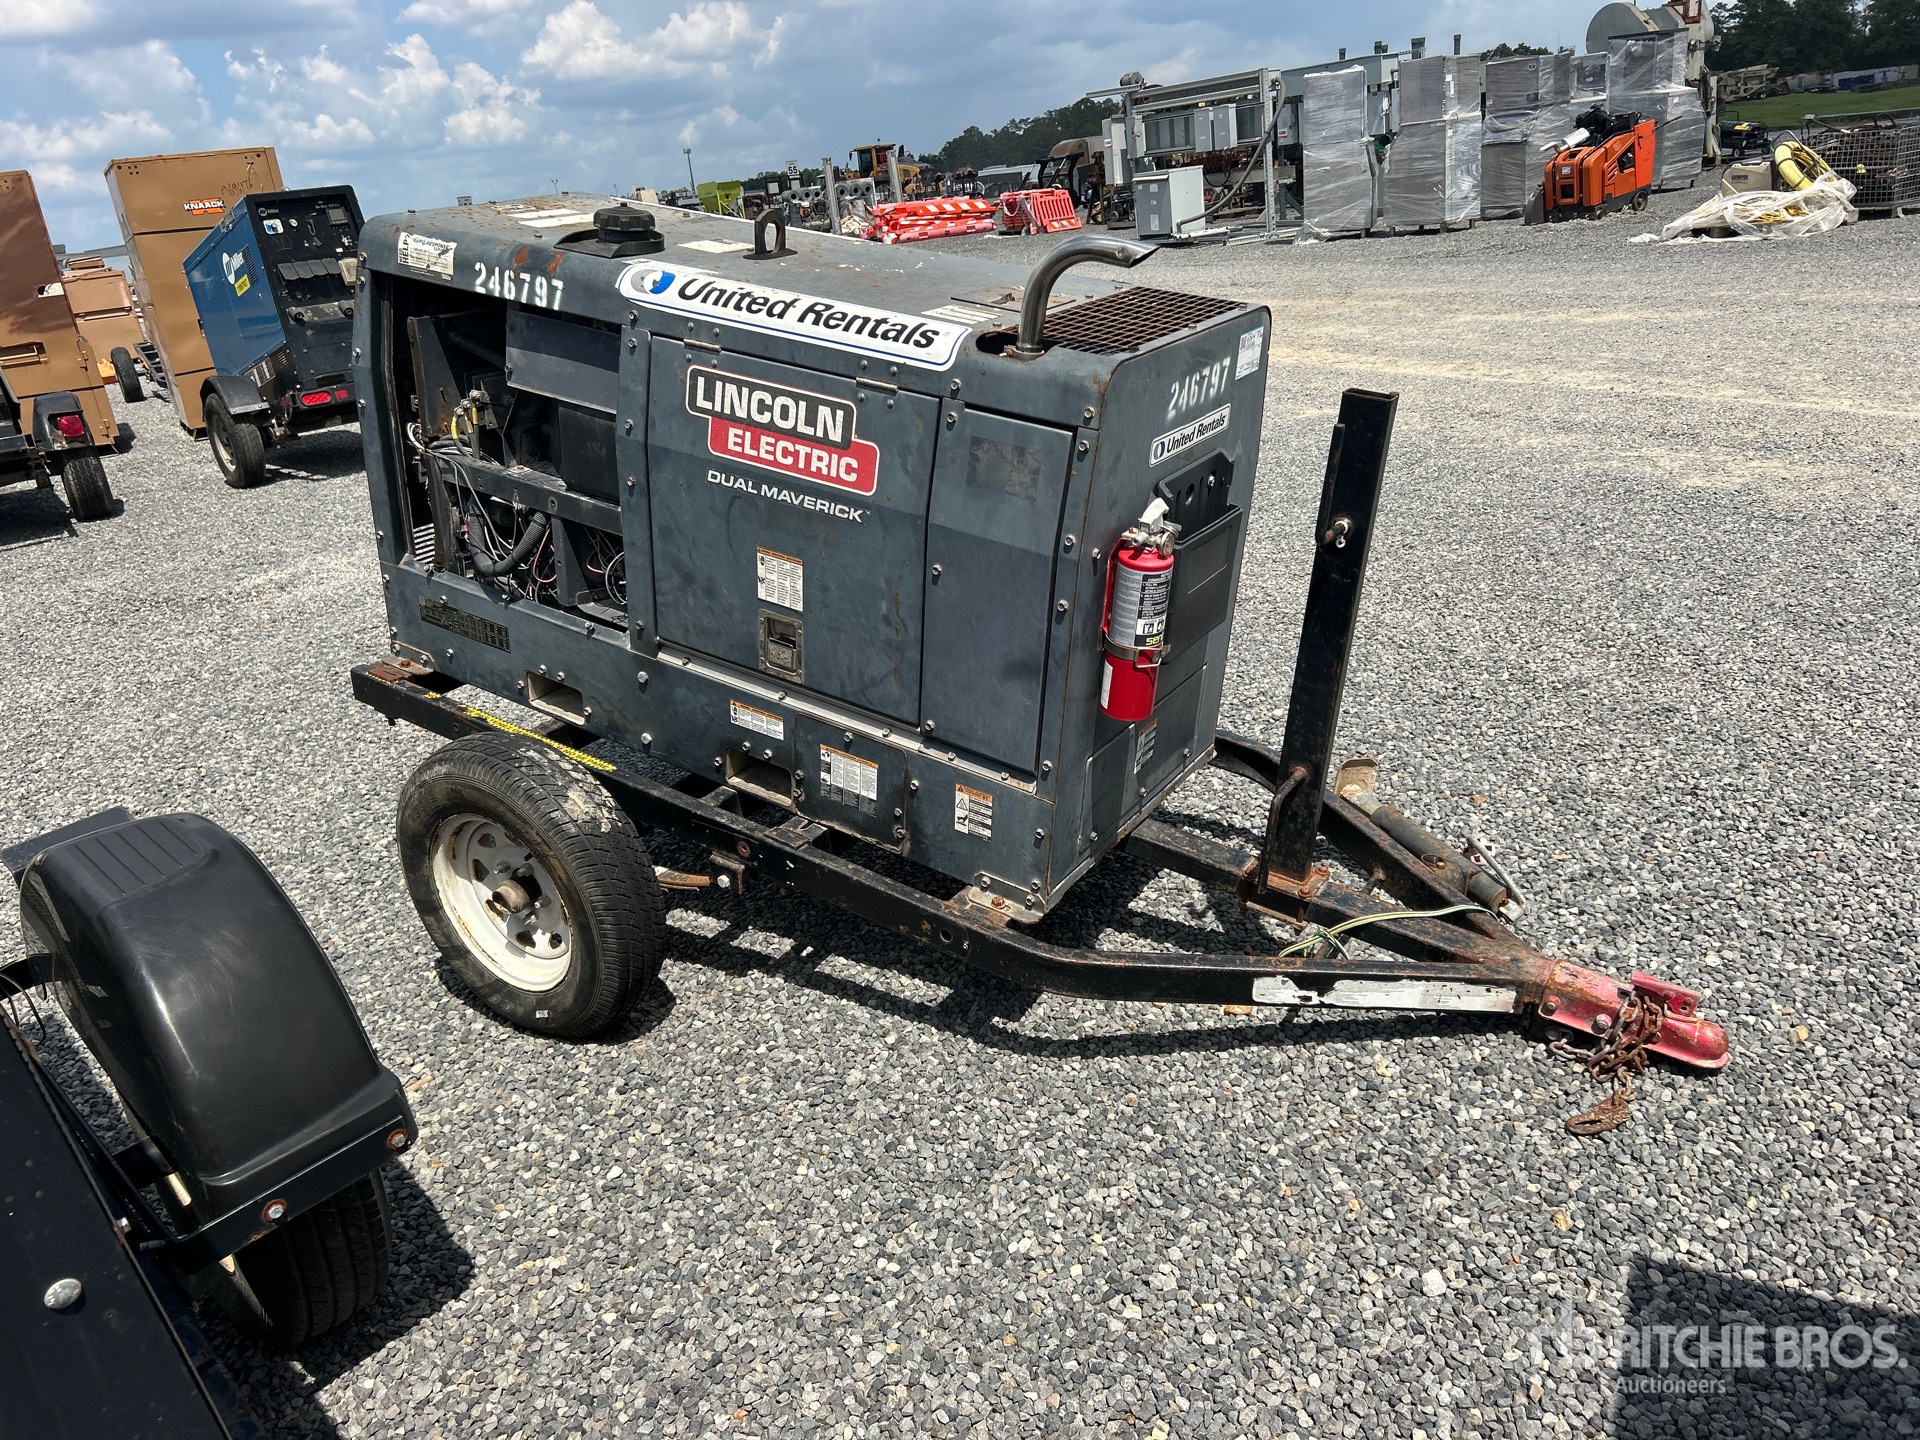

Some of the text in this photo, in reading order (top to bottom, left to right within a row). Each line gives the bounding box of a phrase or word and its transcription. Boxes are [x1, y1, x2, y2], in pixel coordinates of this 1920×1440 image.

[788, 166, 798, 174] 55
[184, 200, 225, 212] KNAACK
[231, 252, 245, 271] Miller
[403, 234, 411, 264] HELP?
[474, 261, 565, 311] 246797
[677, 278, 800, 320] United
[797, 301, 941, 349] Rentals
[695, 375, 844, 443] LINCOLN
[1166, 356, 1232, 420] 246797
[727, 427, 860, 483] ELECTRIC
[1166, 413, 1226, 453] United Rentals
[707, 468, 865, 524] DUAL MAVERICK
